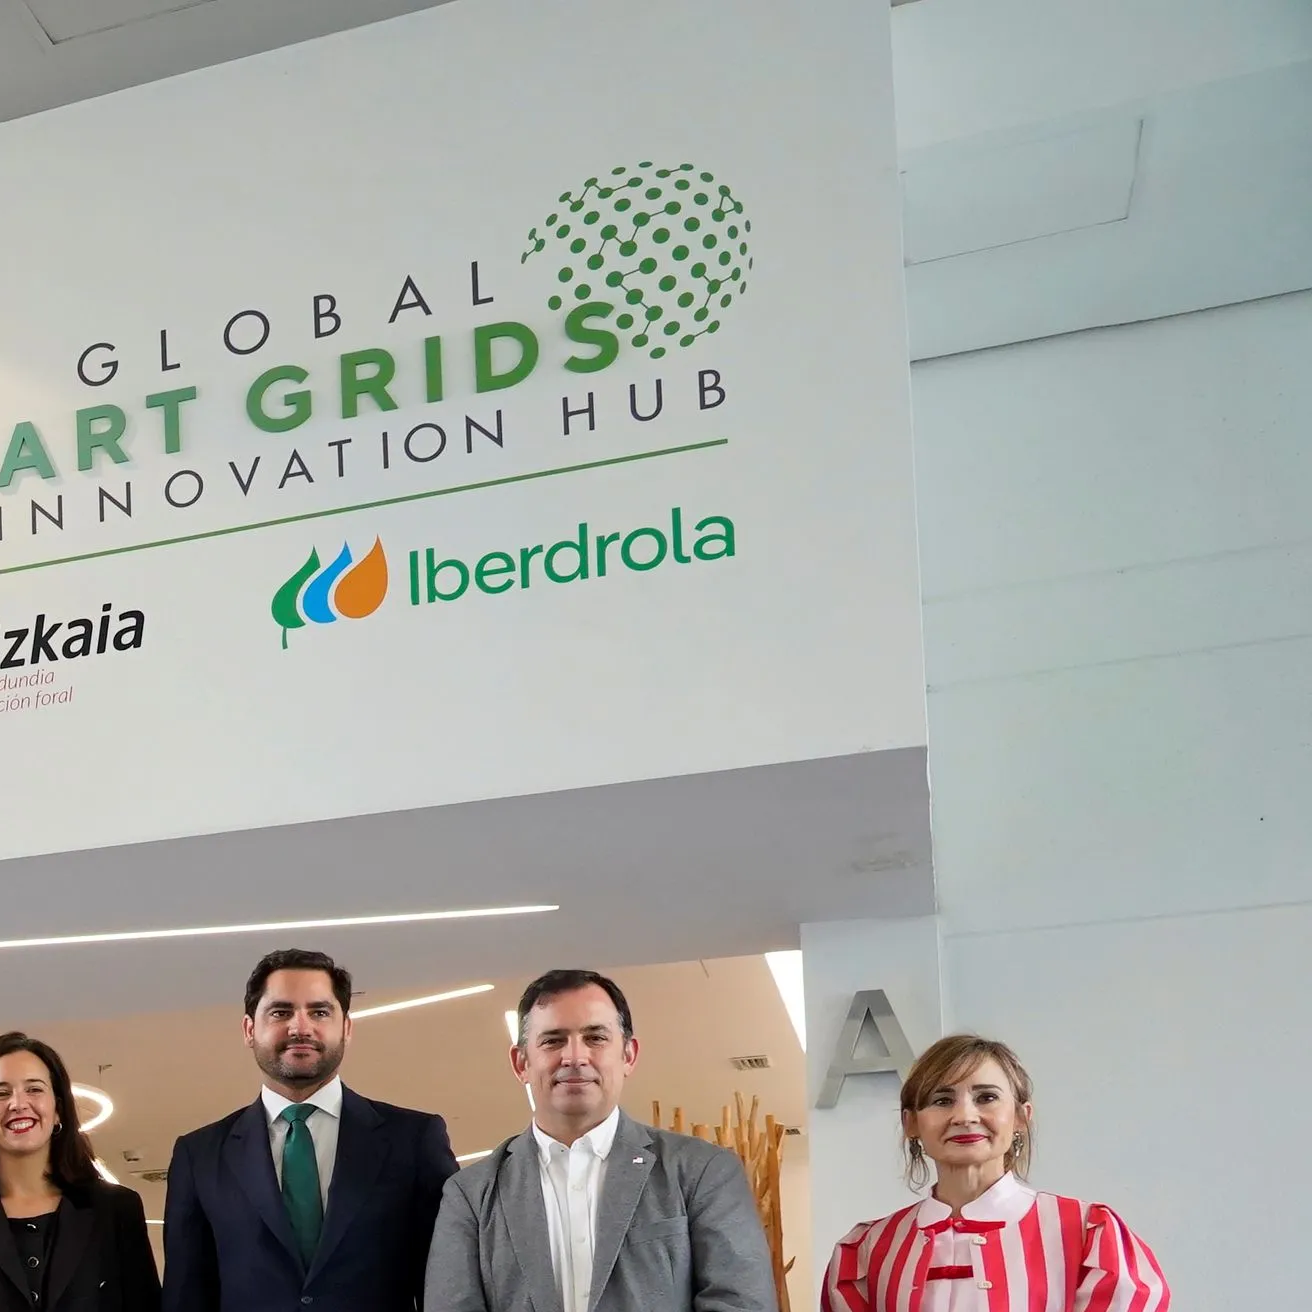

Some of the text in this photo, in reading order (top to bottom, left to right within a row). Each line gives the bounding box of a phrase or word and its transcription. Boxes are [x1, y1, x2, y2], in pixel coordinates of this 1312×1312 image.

[77, 260, 496, 388] GLOBAL
[245, 302, 621, 434] GRIDS
[563, 369, 728, 437] HUB
[408, 507, 736, 605] Iberdrola
[35, 687, 73, 711] foral
